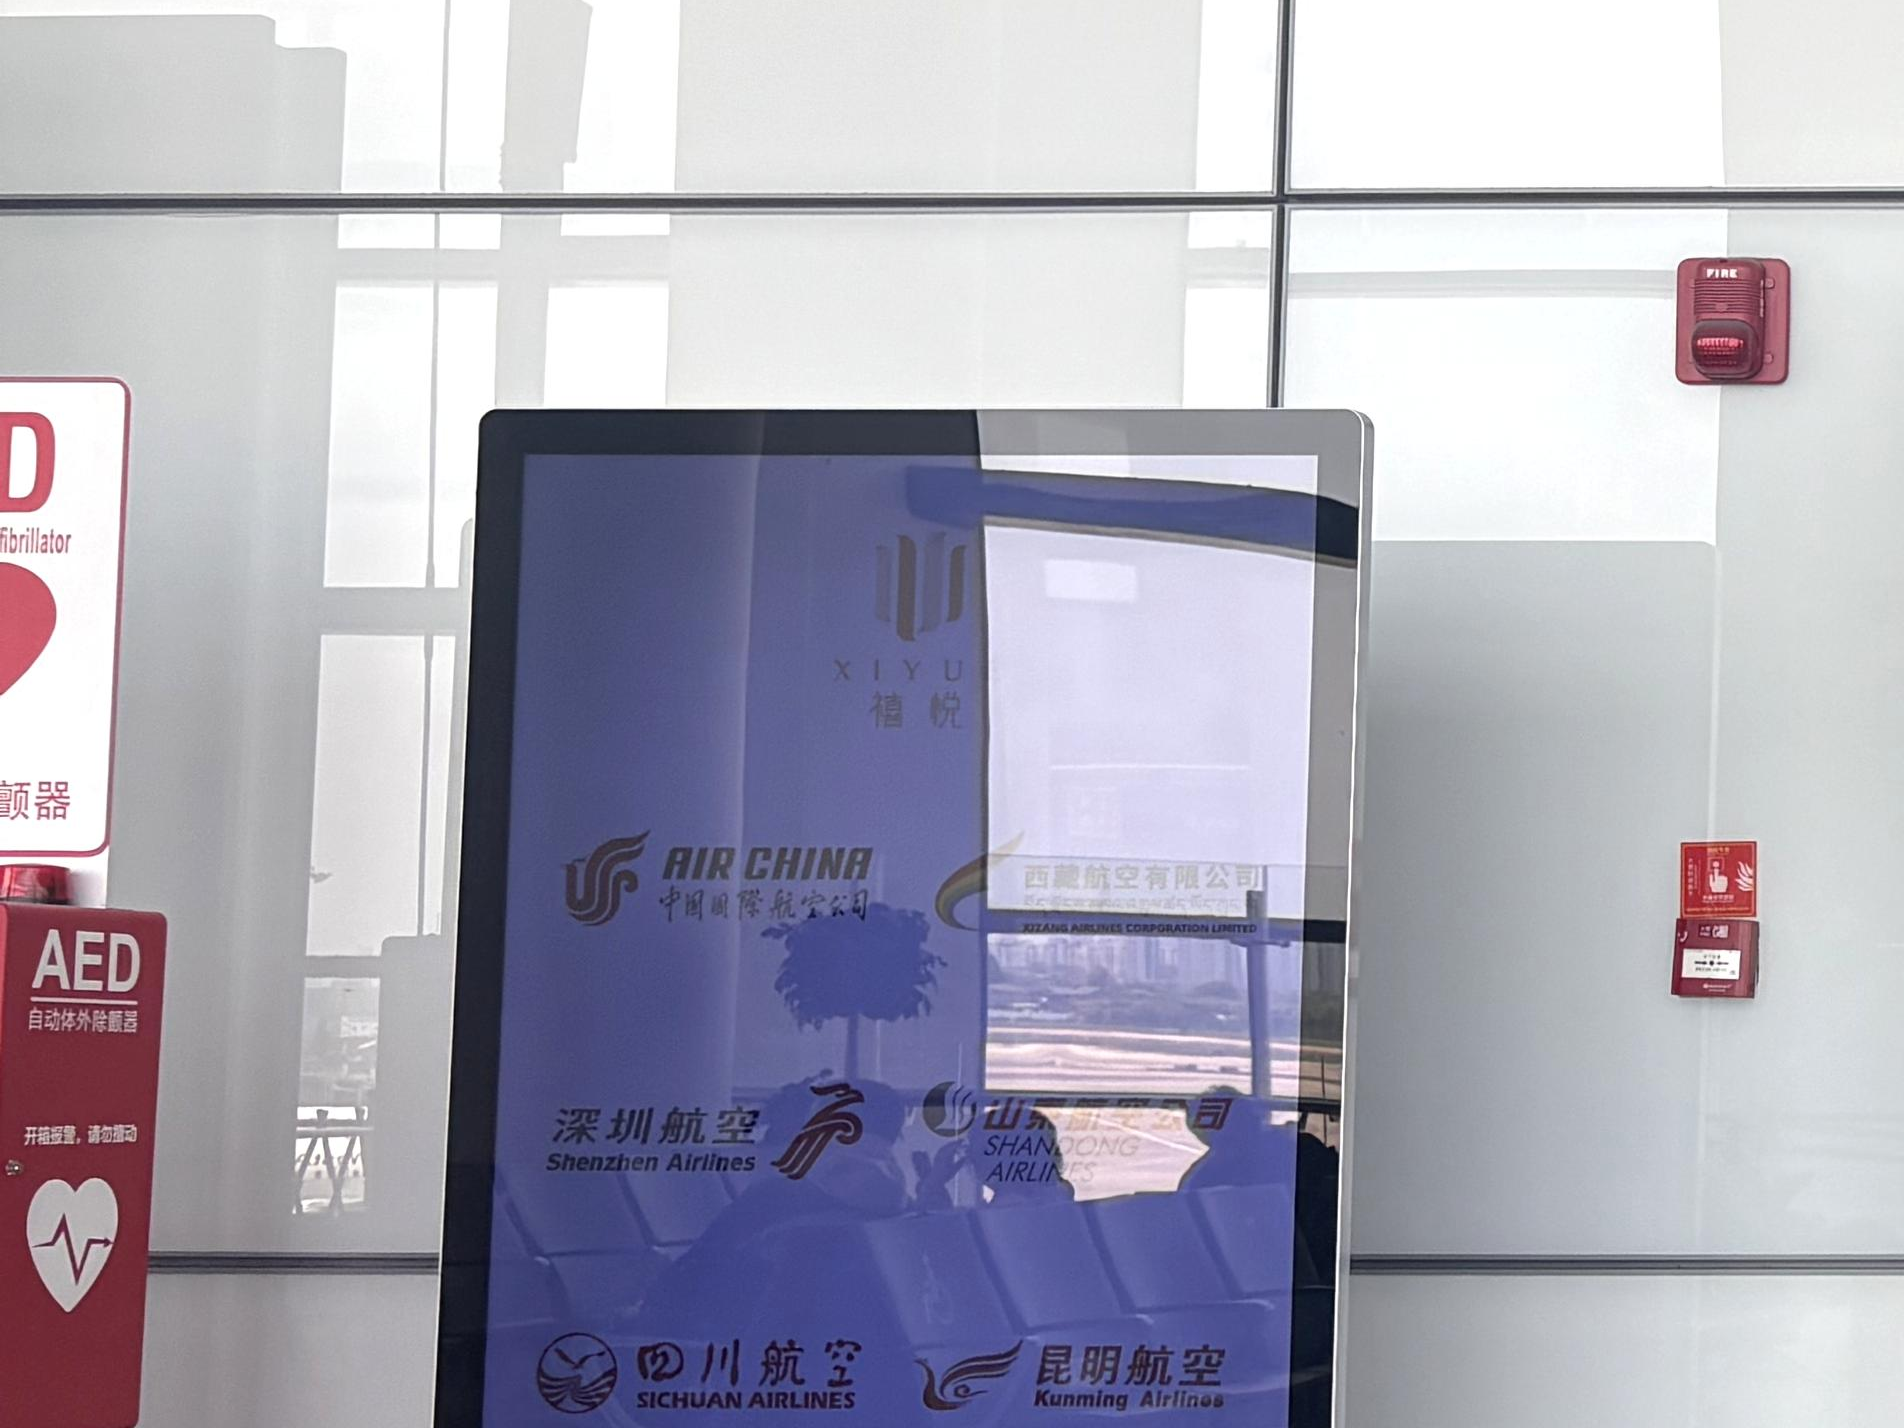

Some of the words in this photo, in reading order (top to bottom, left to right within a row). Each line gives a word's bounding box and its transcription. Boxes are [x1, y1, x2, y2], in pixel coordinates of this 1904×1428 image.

[834, 659, 1002, 682] XIYU
[868, 689, 963, 730] 禧悦
[662, 846, 736, 880] AIR
[744, 846, 874, 880] CHINA
[1023, 864, 1260, 891] 西藏航空有限公司
[1125, 922, 1209, 934] CORPORATION
[31, 929, 141, 992] AED
[28, 1006, 139, 1033] 自动体外除颤器
[551, 1105, 761, 1145] 深圳航空
[984, 1135, 1141, 1158] SHANDONG
[546, 1152, 659, 1173] Shenzhen
[665, 1152, 756, 1173] Airlines
[986, 1160, 1098, 1183] AIRLINES
[637, 1338, 863, 1388] 四川航空
[1036, 1343, 1226, 1387] 昆明航空
[636, 1391, 743, 1409] SICHUAN
[748, 1391, 856, 1409] AIRLINES
[1034, 1389, 1129, 1412] Kunming
[1139, 1389, 1225, 1409] Airlines
